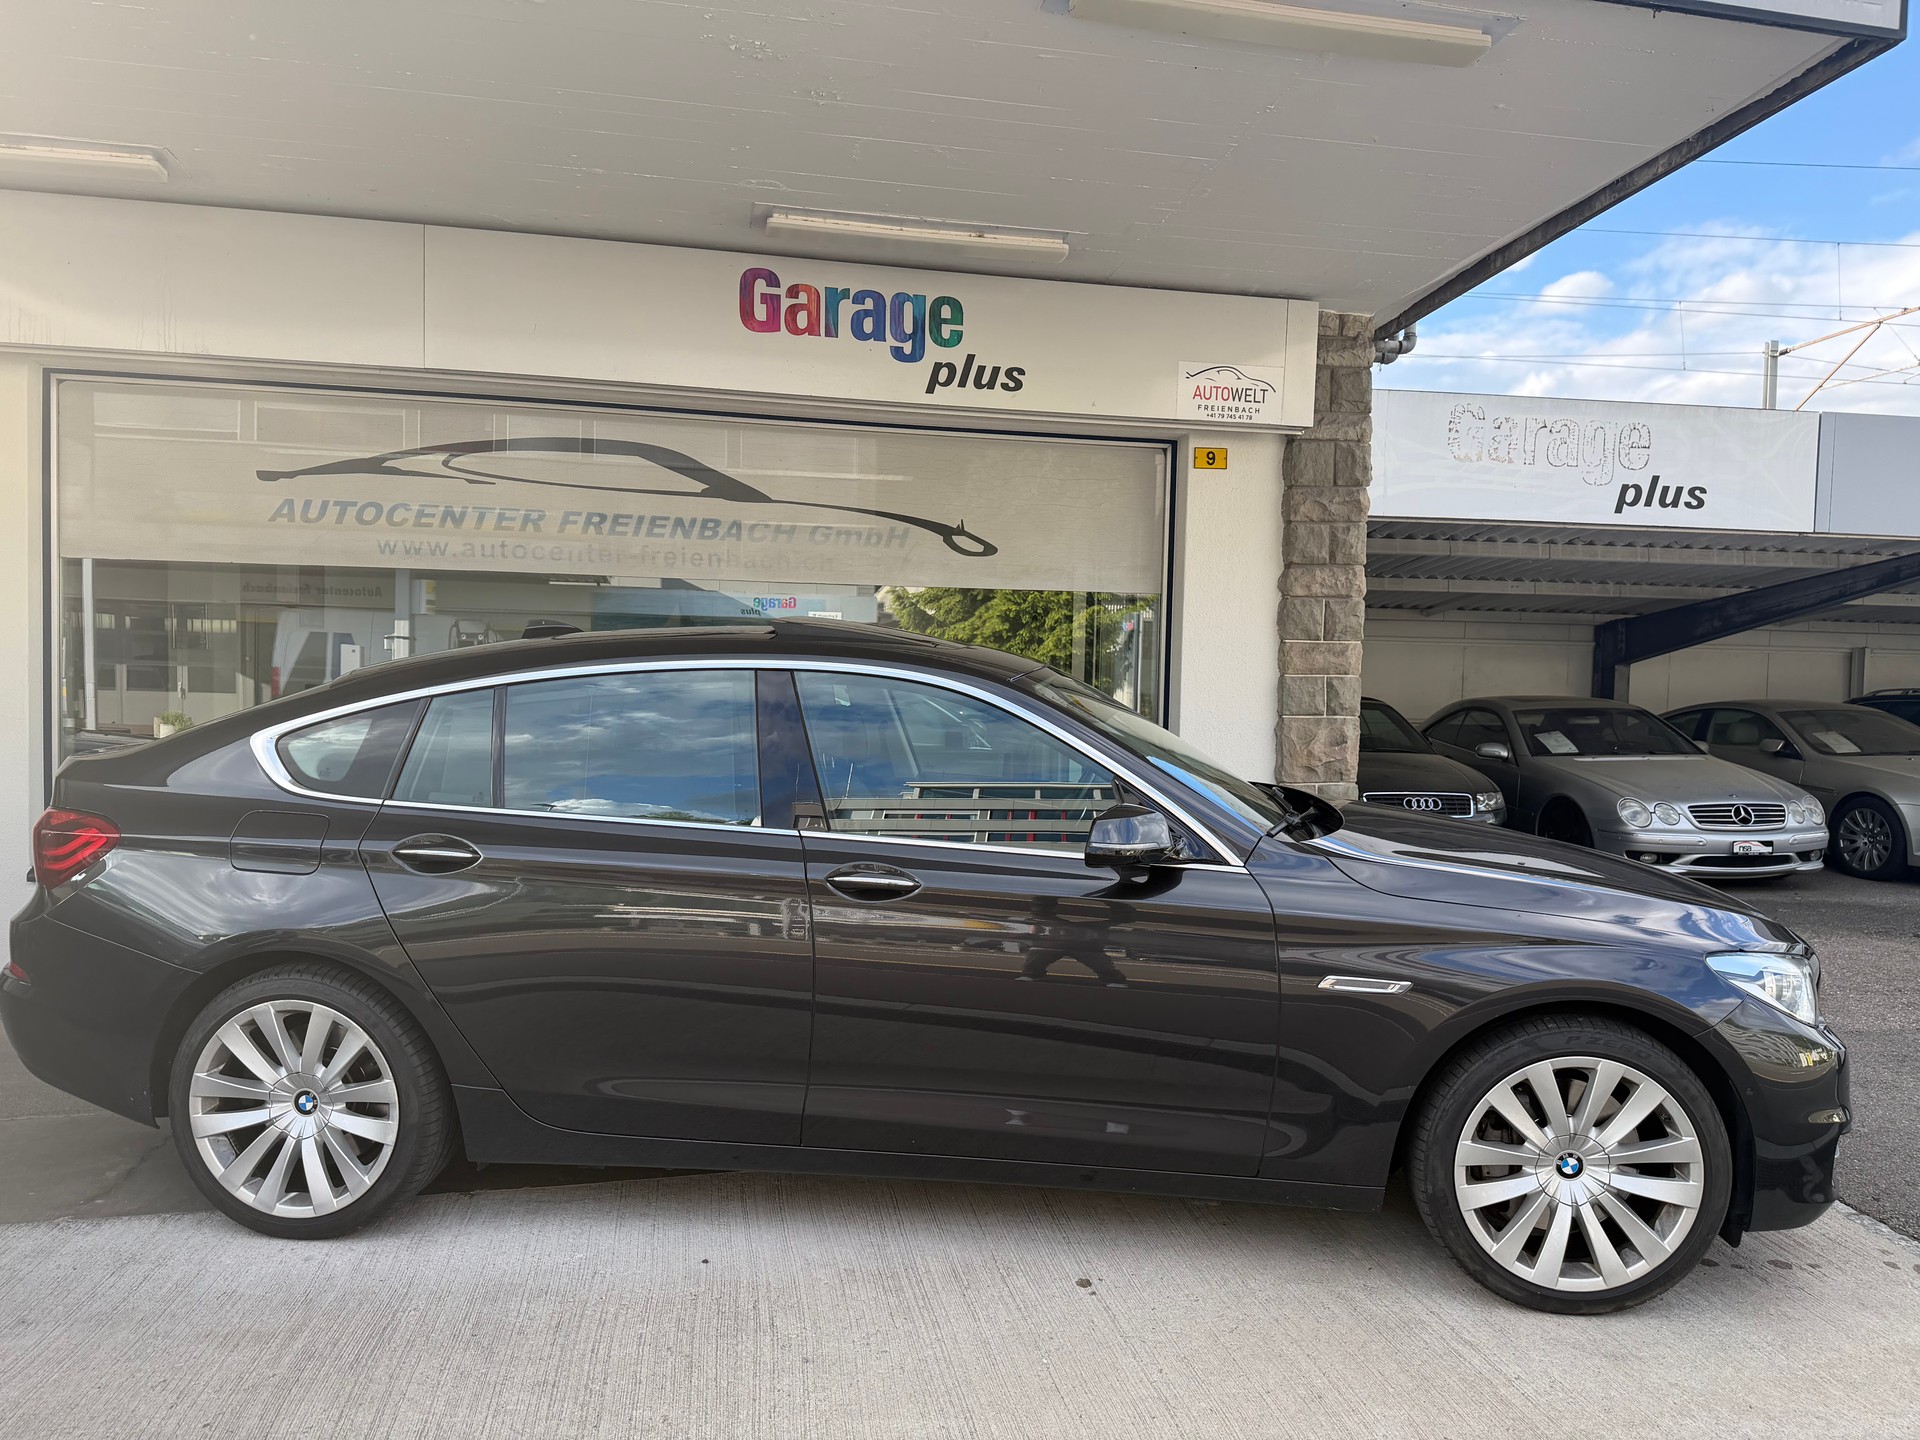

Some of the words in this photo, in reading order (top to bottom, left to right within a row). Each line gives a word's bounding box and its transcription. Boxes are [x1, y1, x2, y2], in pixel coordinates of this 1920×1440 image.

[739, 267, 964, 363] Garage
[925, 353, 1026, 394] plus
[1192, 385, 1269, 404] AUTOWELT
[1197, 404, 1261, 414] FREIENBACH
[1206, 451, 1216, 466] 9
[1447, 403, 1652, 486] Garage
[1614, 475, 1708, 514] plus
[267, 498, 546, 534] AUTOCENTER
[556, 510, 798, 545] FREIENBACH
[807, 523, 911, 549] GmbH
